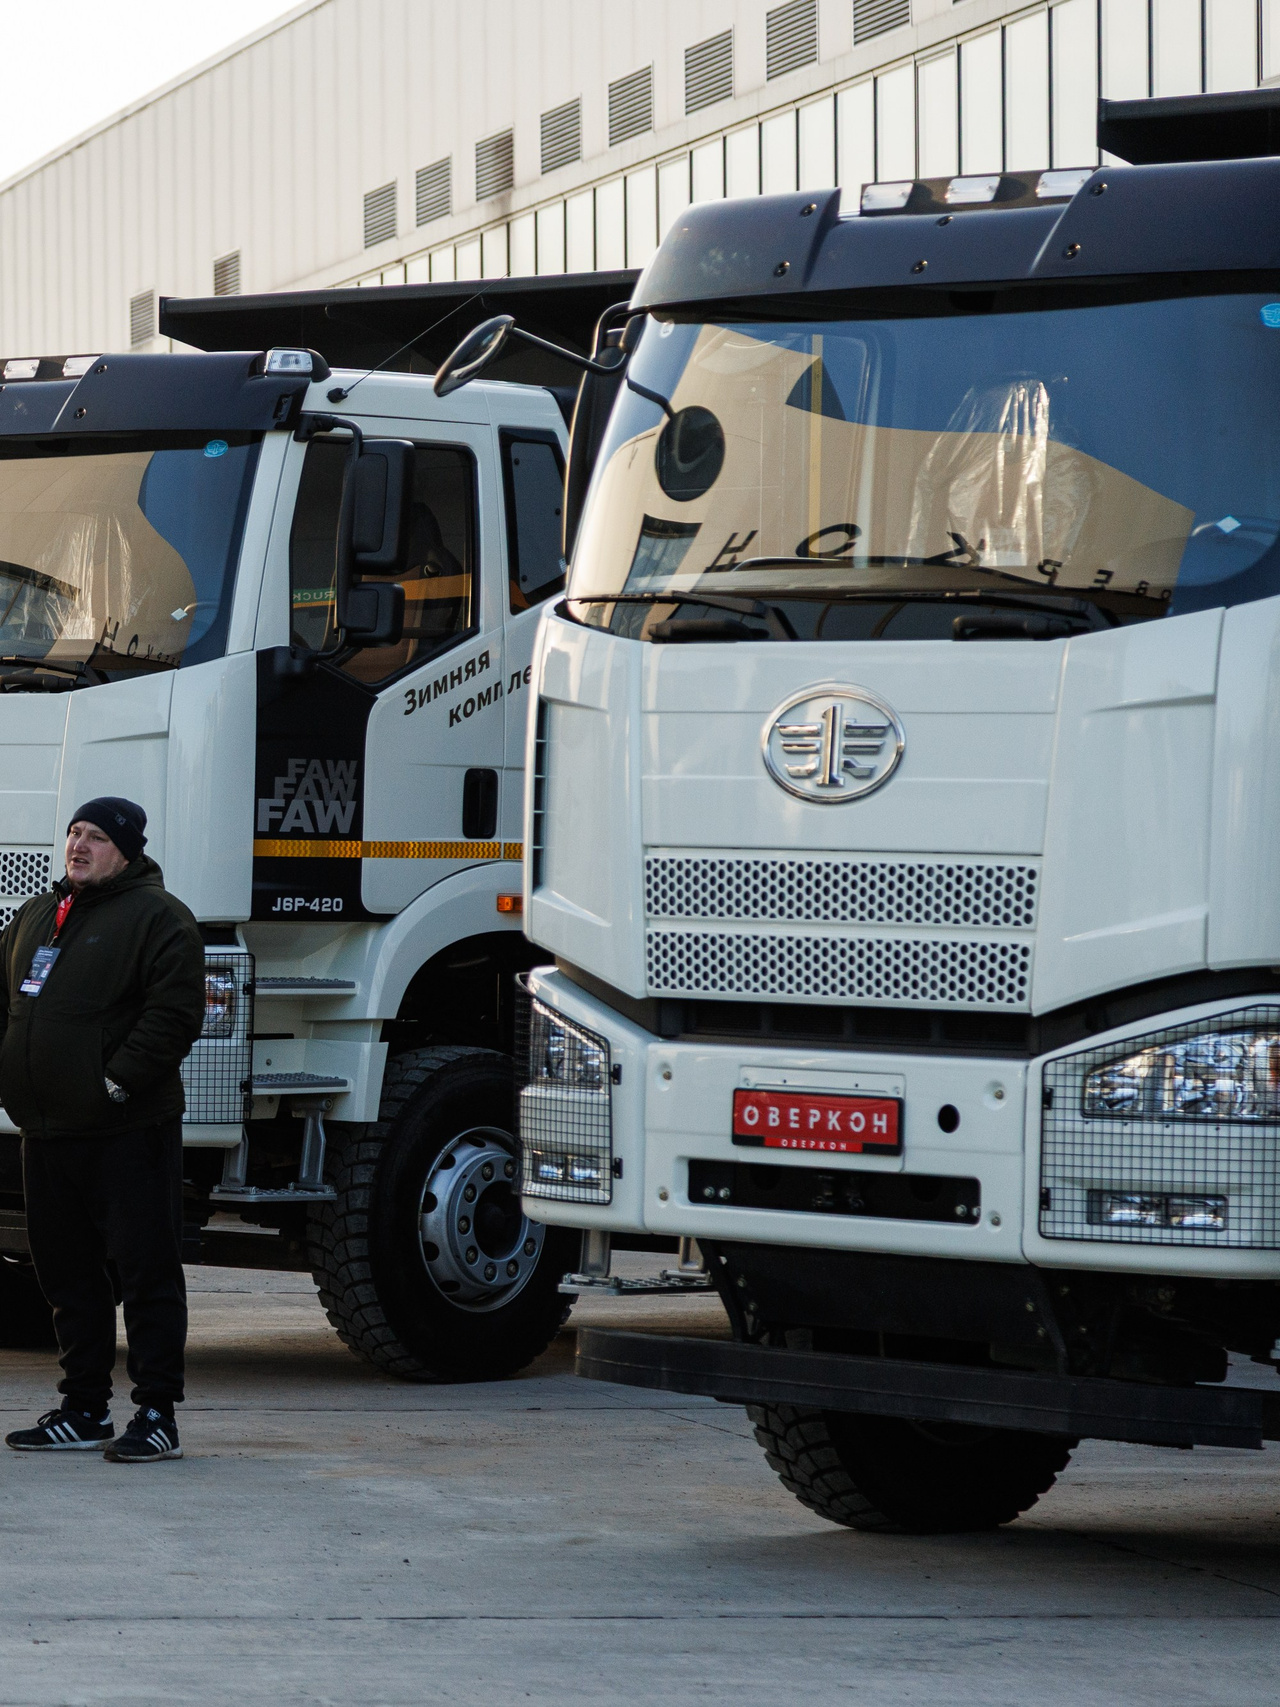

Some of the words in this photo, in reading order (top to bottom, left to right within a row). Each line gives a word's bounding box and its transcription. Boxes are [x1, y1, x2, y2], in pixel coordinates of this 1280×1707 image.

[404, 650, 490, 715] Зимняя
[449, 665, 533, 728] компле
[287, 758, 358, 785] FAW
[274, 776, 358, 807] FAW
[257, 798, 357, 834] FAW
[272, 897, 343, 912] J6P-420
[743, 1105, 888, 1134] ОВЕРКОН
[780, 1139, 847, 1150] ОВЕРКОН
